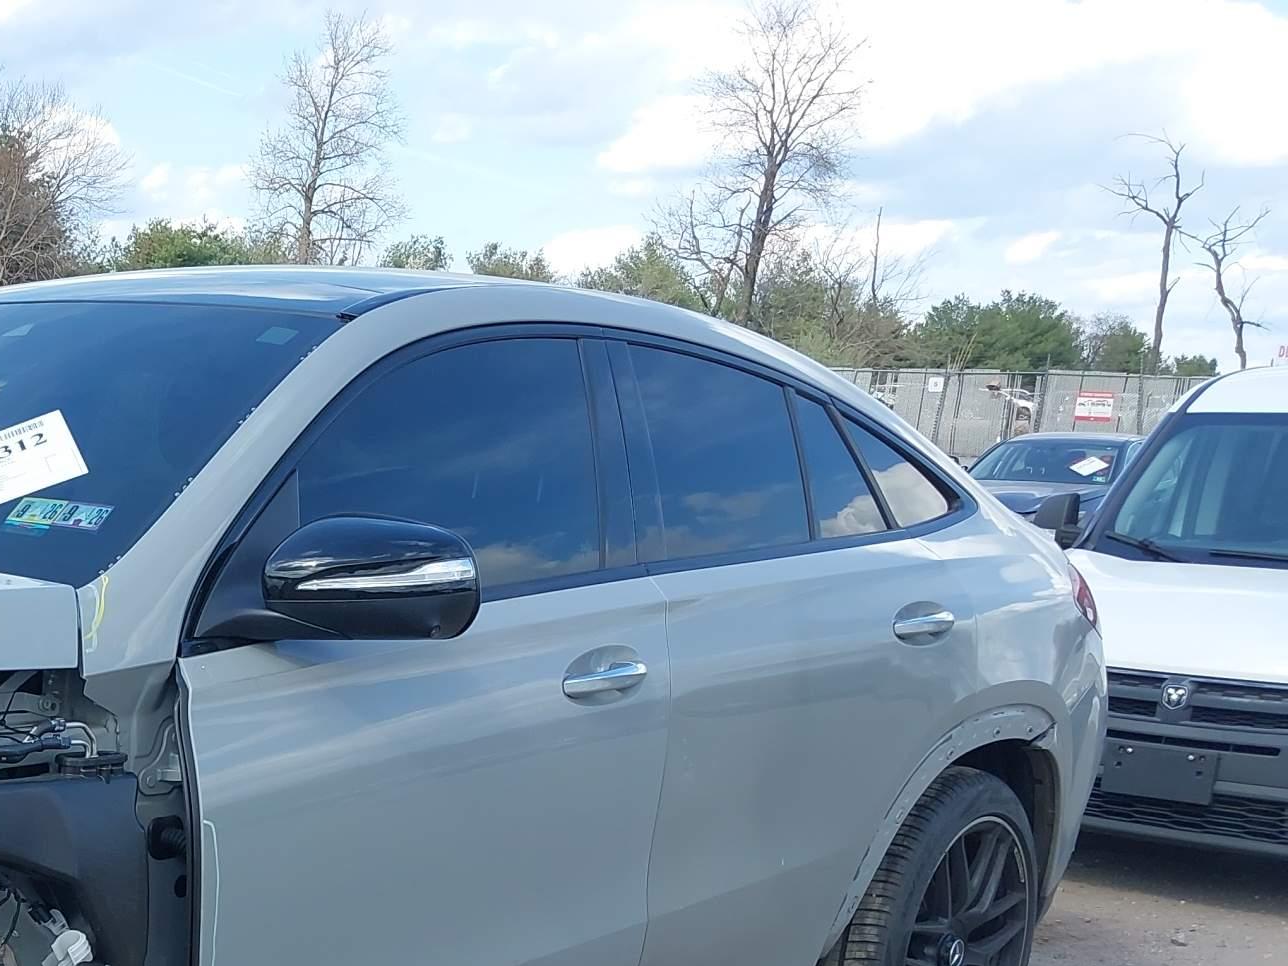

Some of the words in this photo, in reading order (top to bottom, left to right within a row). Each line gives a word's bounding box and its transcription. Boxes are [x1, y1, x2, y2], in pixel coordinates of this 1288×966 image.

[15, 504, 31, 519] 9
[42, 503, 61, 521] 26
[62, 505, 78, 521] 9
